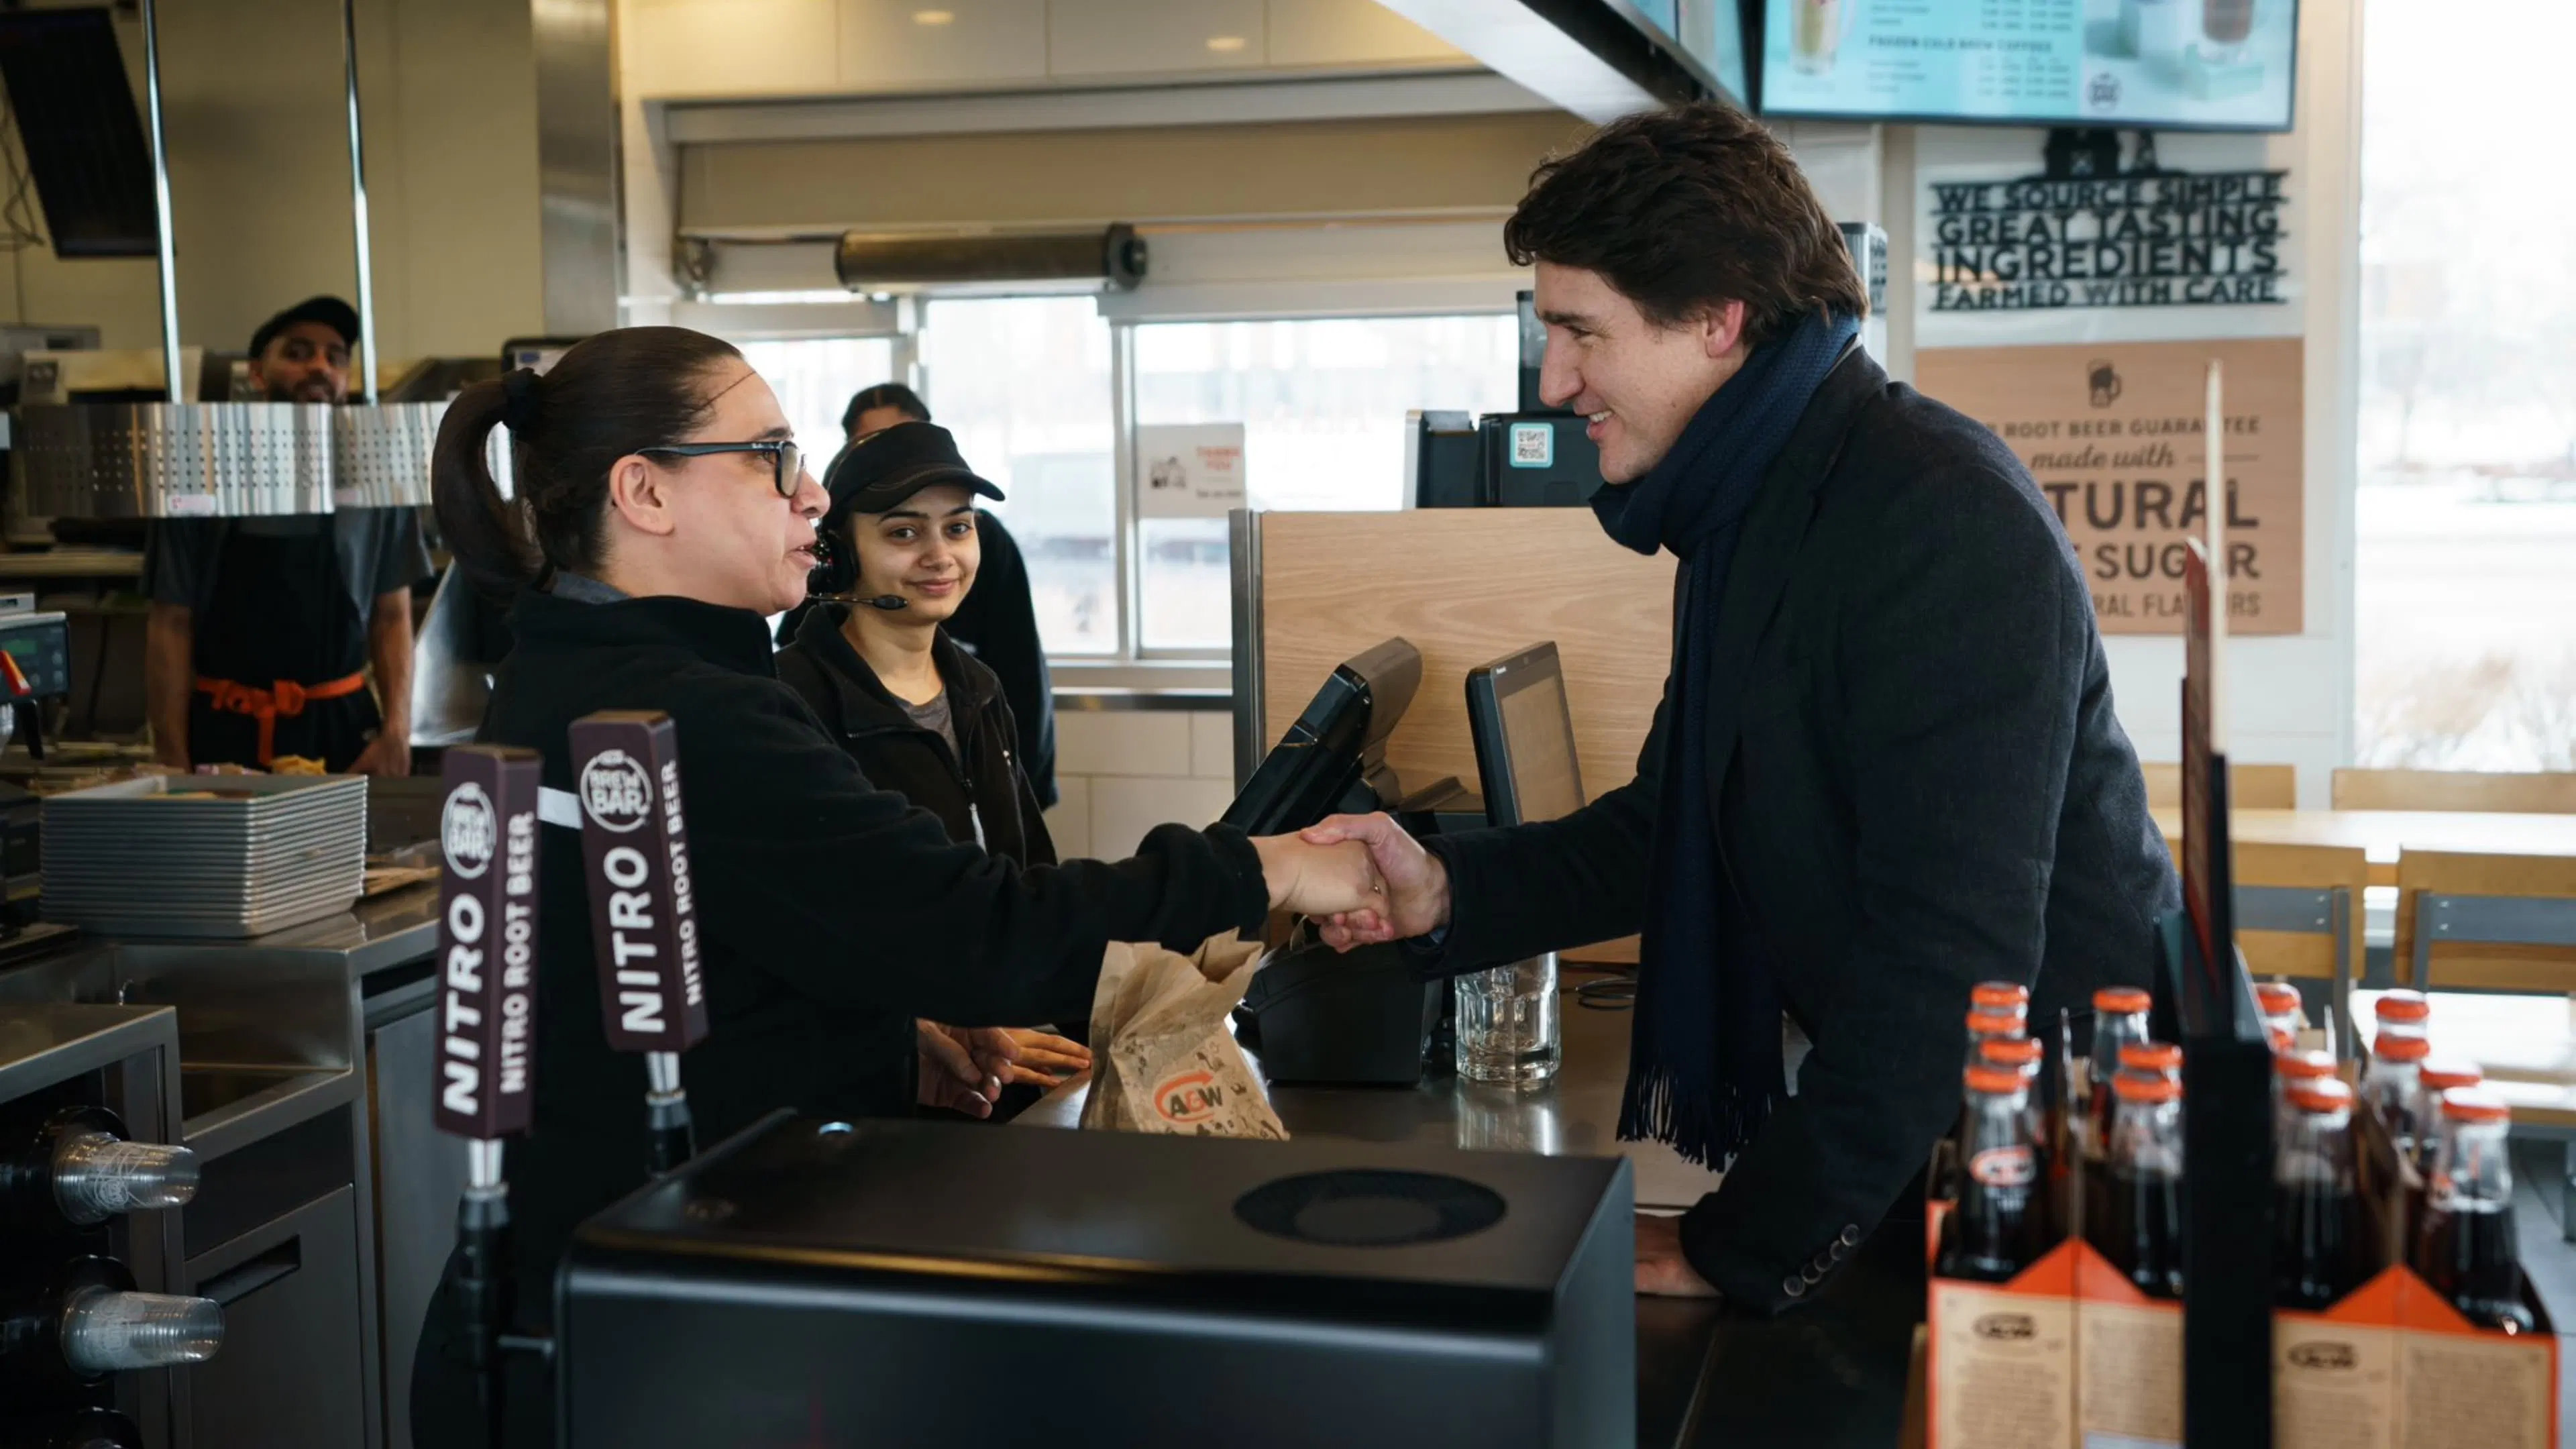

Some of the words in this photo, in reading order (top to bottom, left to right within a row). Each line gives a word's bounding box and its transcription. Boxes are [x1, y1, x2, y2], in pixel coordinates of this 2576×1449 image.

[1937, 184, 1988, 212] WE
[2007, 182, 2140, 210] SOURCE
[2157, 174, 2282, 206] SIMPLE
[1937, 211, 2074, 246] GREAT
[2096, 203, 2278, 240] TASTING
[1936, 239, 2277, 282] INGREDIENTS
[1937, 283, 2070, 309] FARMED
[2083, 278, 2171, 305] WITH
[2186, 274, 2279, 304] CARE
[2004, 421, 2059, 438] ROOT
[2069, 419, 2122, 436] BEER
[2129, 415, 2259, 435] GUARATEE
[2030, 443, 2108, 470] made
[2112, 441, 2174, 468] with
[2043, 479, 2259, 529] TURAL
[2095, 541, 2261, 580] SUGR
[589, 769, 642, 789] BREW
[661, 759, 684, 835] BEER
[590, 788, 649, 815] BAR
[506, 810, 535, 896] BEER
[668, 841, 693, 915] ROOT
[503, 901, 532, 988] ROOT
[603, 845, 666, 1034] NITRO
[678, 919, 702, 1007] NITRO
[443, 893, 485, 1116] NITRO
[499, 992, 529, 1093] NITRO
[1169, 1085, 1223, 1116] A&W
